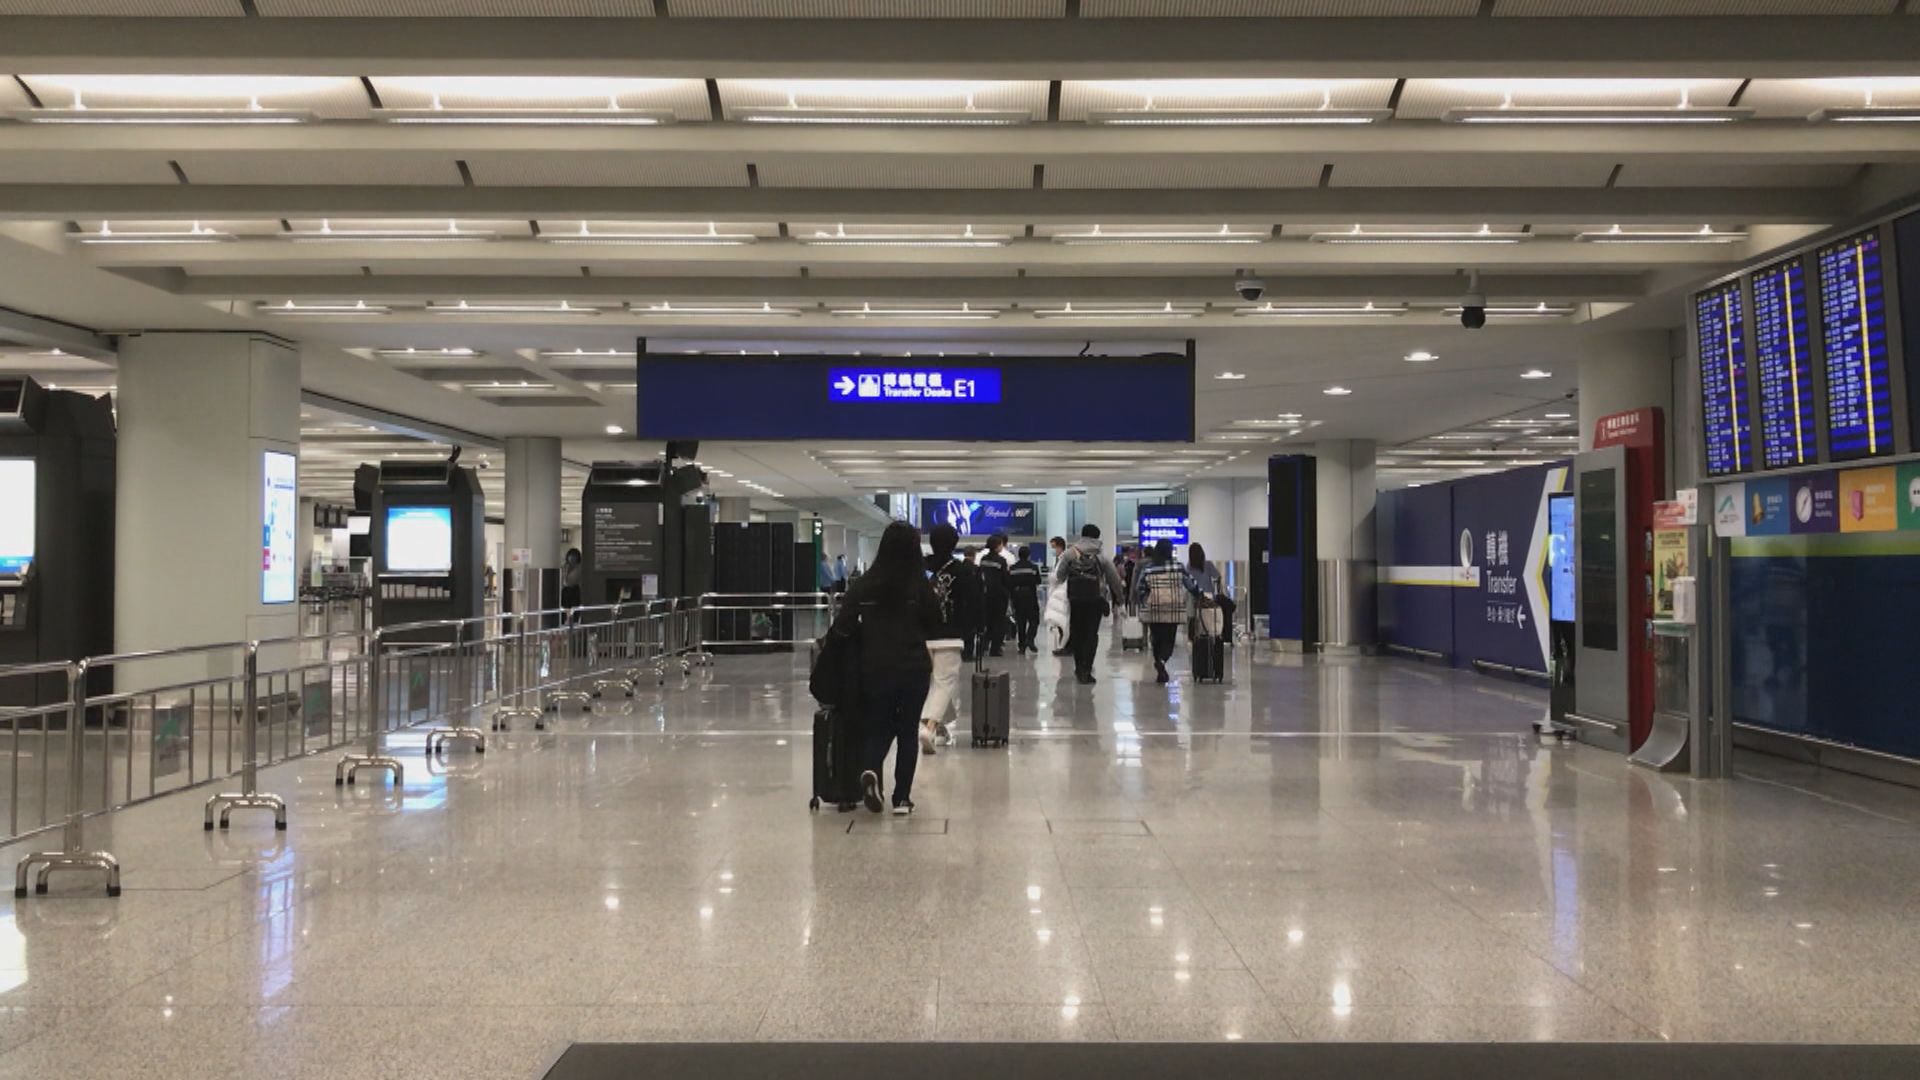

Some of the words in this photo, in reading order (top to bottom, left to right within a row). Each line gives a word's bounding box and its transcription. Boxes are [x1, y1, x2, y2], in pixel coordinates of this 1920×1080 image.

[884, 386, 922, 397] Transfer
[955, 379, 975, 397] E1
[1486, 570, 1517, 593] Transfer
